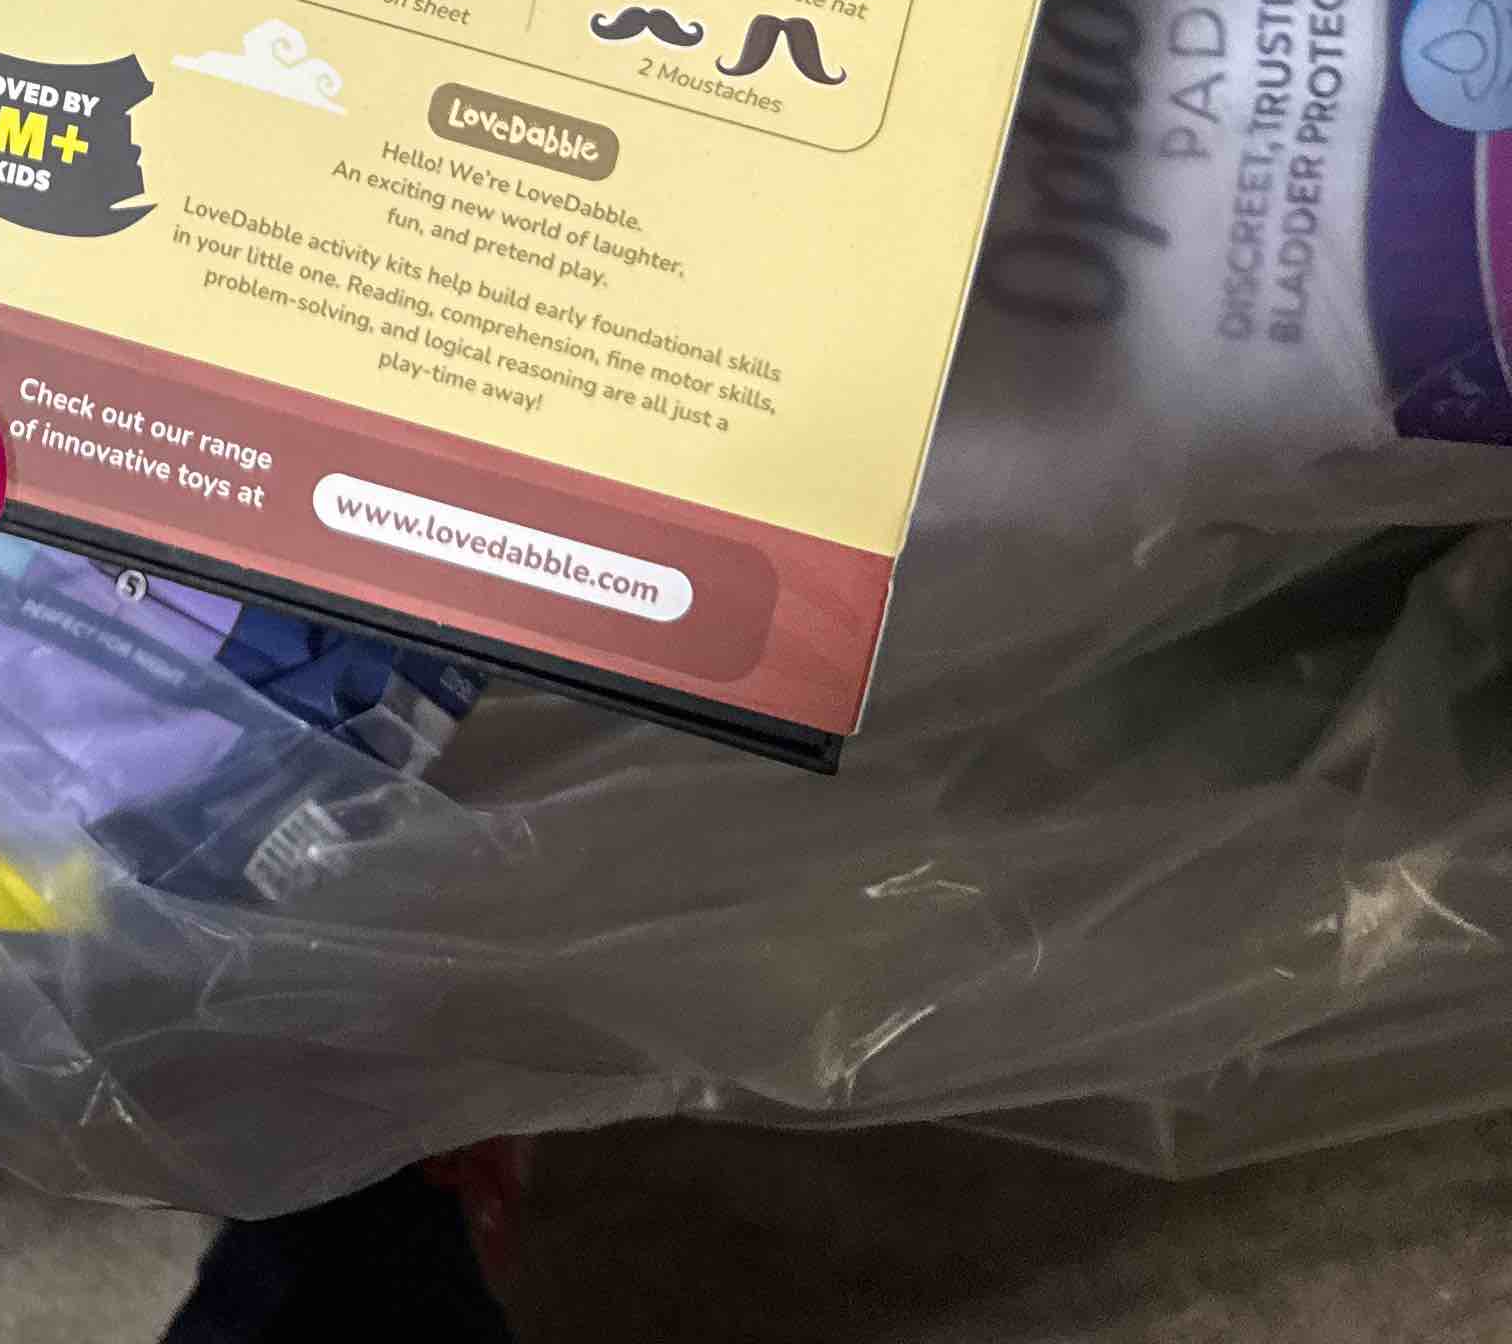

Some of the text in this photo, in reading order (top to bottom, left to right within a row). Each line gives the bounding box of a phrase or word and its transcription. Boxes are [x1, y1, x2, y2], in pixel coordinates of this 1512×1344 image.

[61, 89, 101, 118] BY
[446, 96, 600, 163] LoveDabble
[636, 56, 784, 114] 2 Moustaches
[330, 158, 685, 279] An exciting new world of laughter,
[380, 139, 643, 233] Hello! We're LoveDabble.
[182, 194, 782, 384] LoveDabble activity kits help build early foundational skills
[386, 206, 609, 288] fun, and pretend play.
[1269, 154, 1323, 344] BLADDER
[171, 222, 777, 417] in your little one. Reading, comprehension, fine motor skills,
[202, 268, 730, 434] problem-solving, and logical reasoning are all just a
[18, 376, 274, 471] Check out our range
[376, 350, 544, 414] play-time away!
[8, 417, 266, 510] of innovative toys at
[335, 494, 660, 605] www.lovedabble.com
